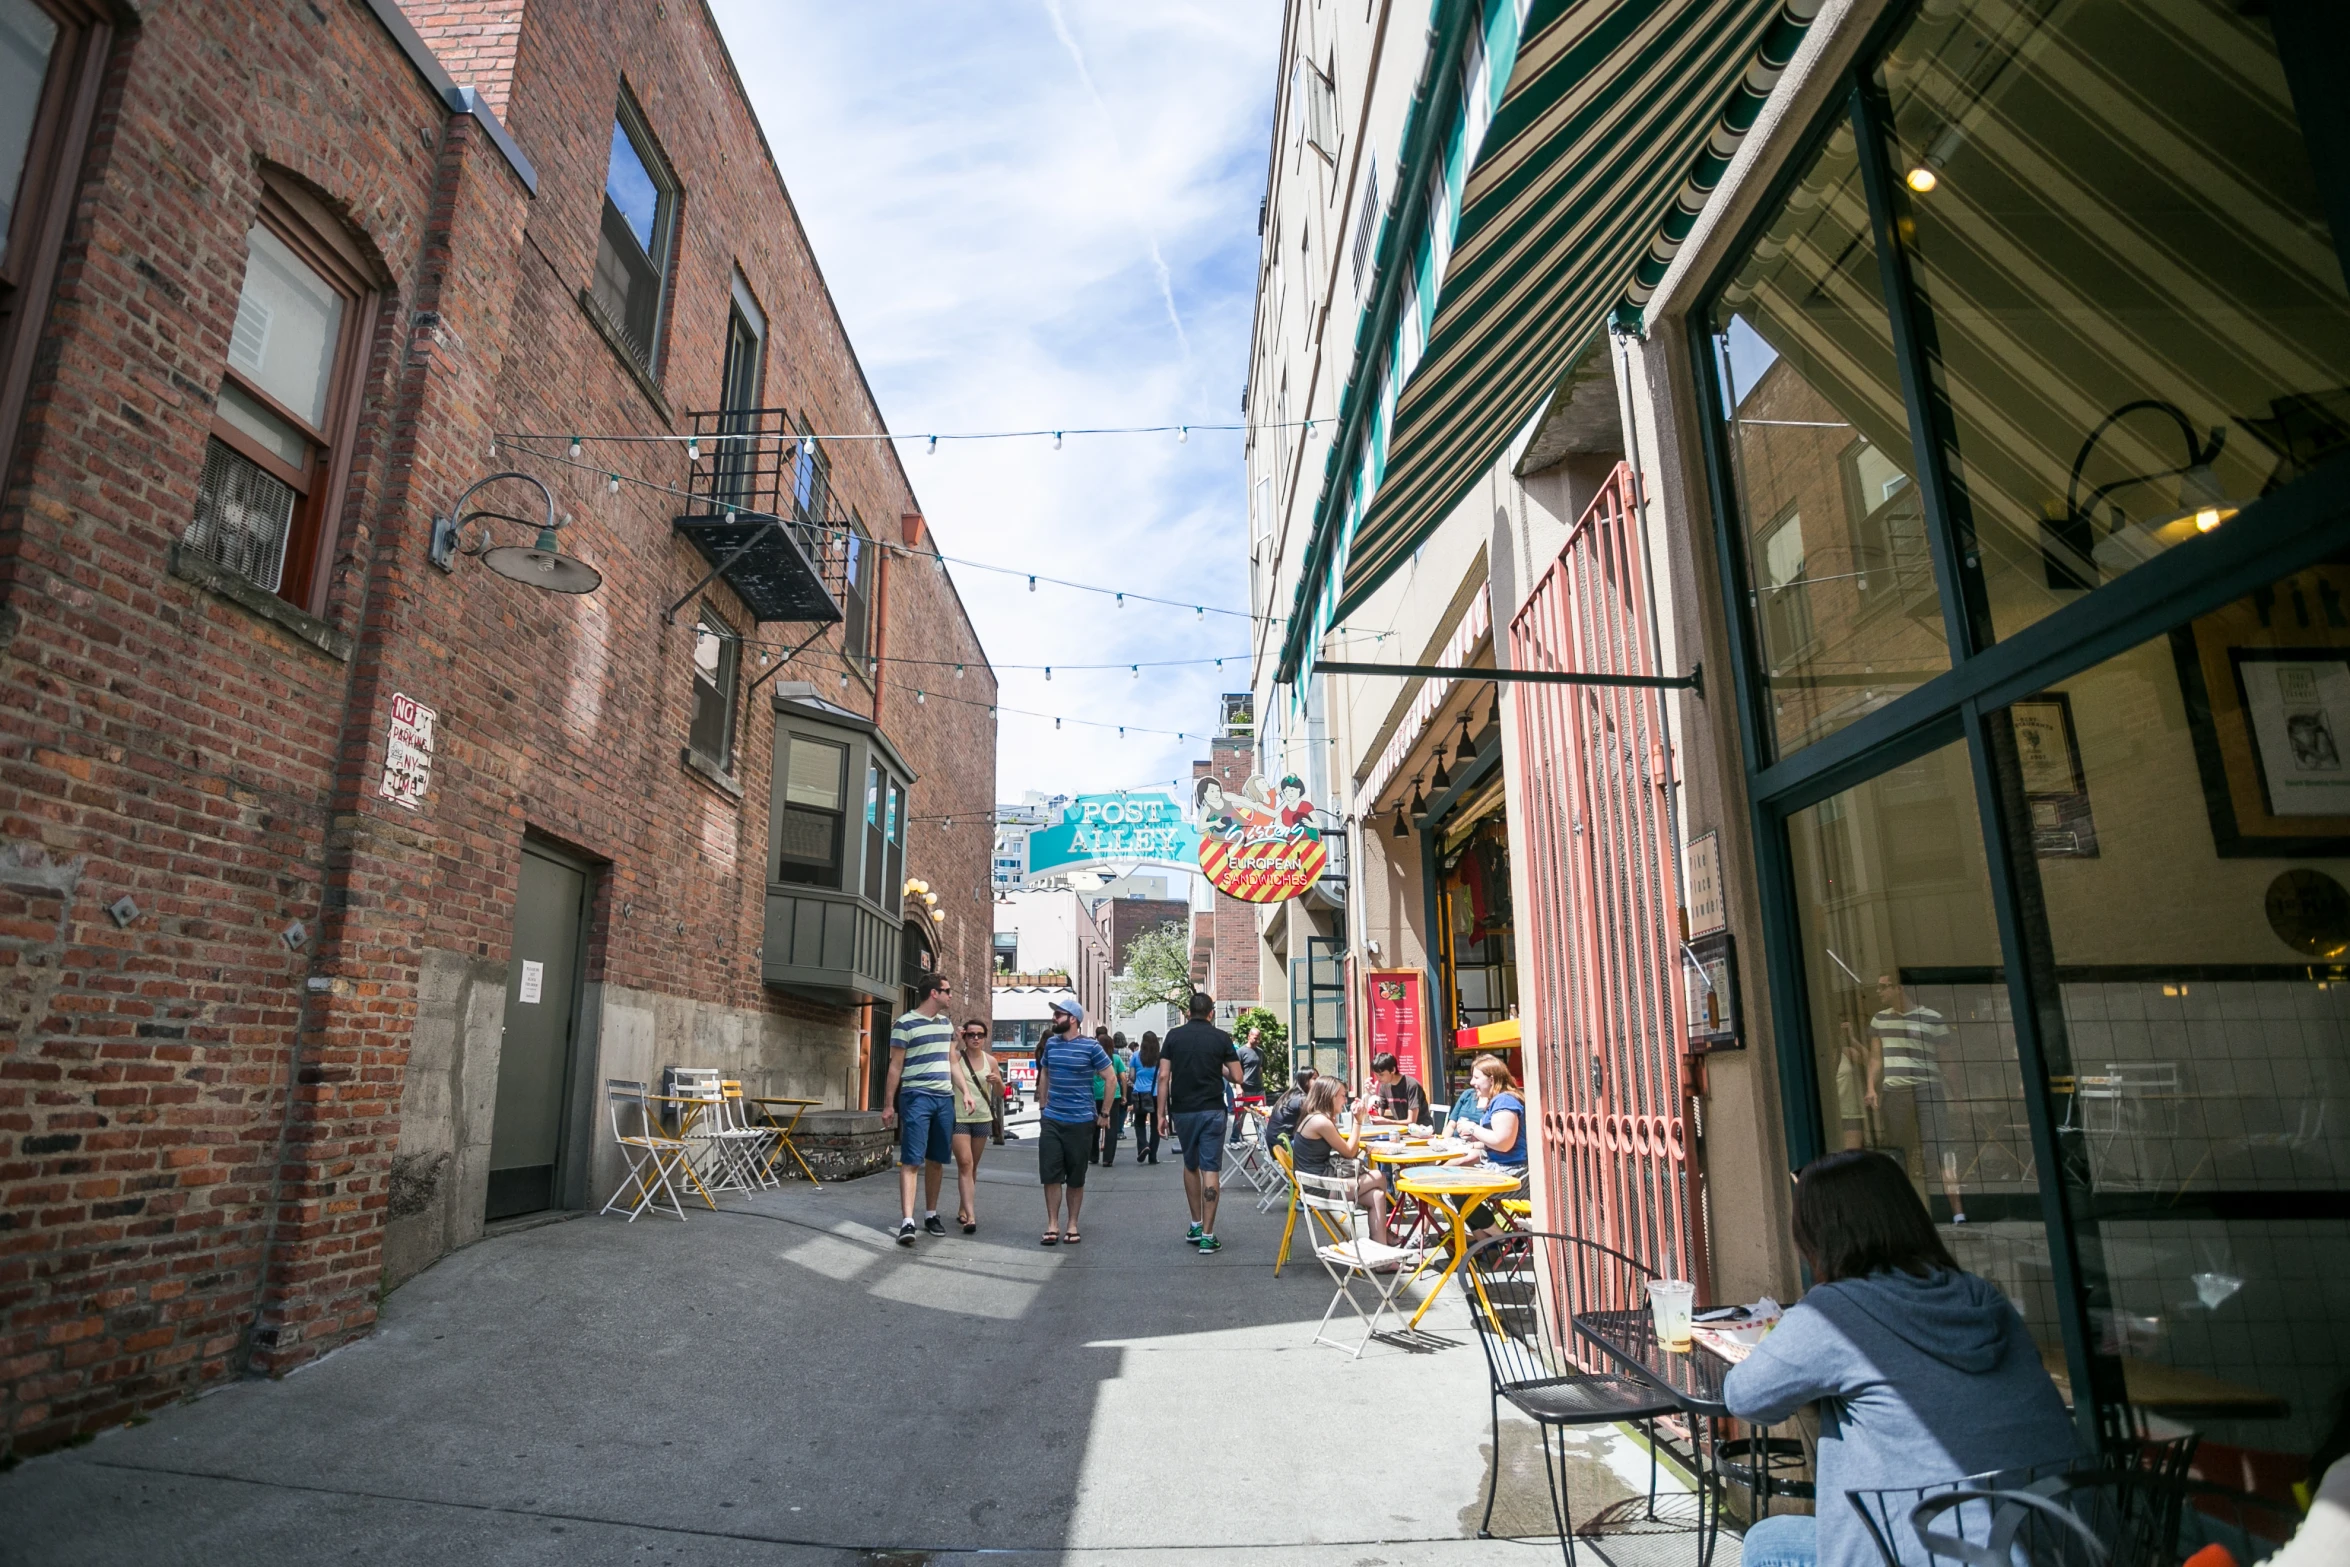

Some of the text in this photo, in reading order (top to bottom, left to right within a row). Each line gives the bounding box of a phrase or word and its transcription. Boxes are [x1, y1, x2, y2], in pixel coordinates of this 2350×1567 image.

[395, 698, 414, 722] NO
[1082, 801, 1164, 824] POST
[1067, 828, 1178, 853] ALLEY
[1224, 821, 1305, 856] Sisters
[1228, 858, 1302, 870] EUROPEAN
[1688, 853, 1707, 872] Pike
[1223, 873, 1308, 886] SANDWICHES
[1689, 876, 1711, 896] Place
